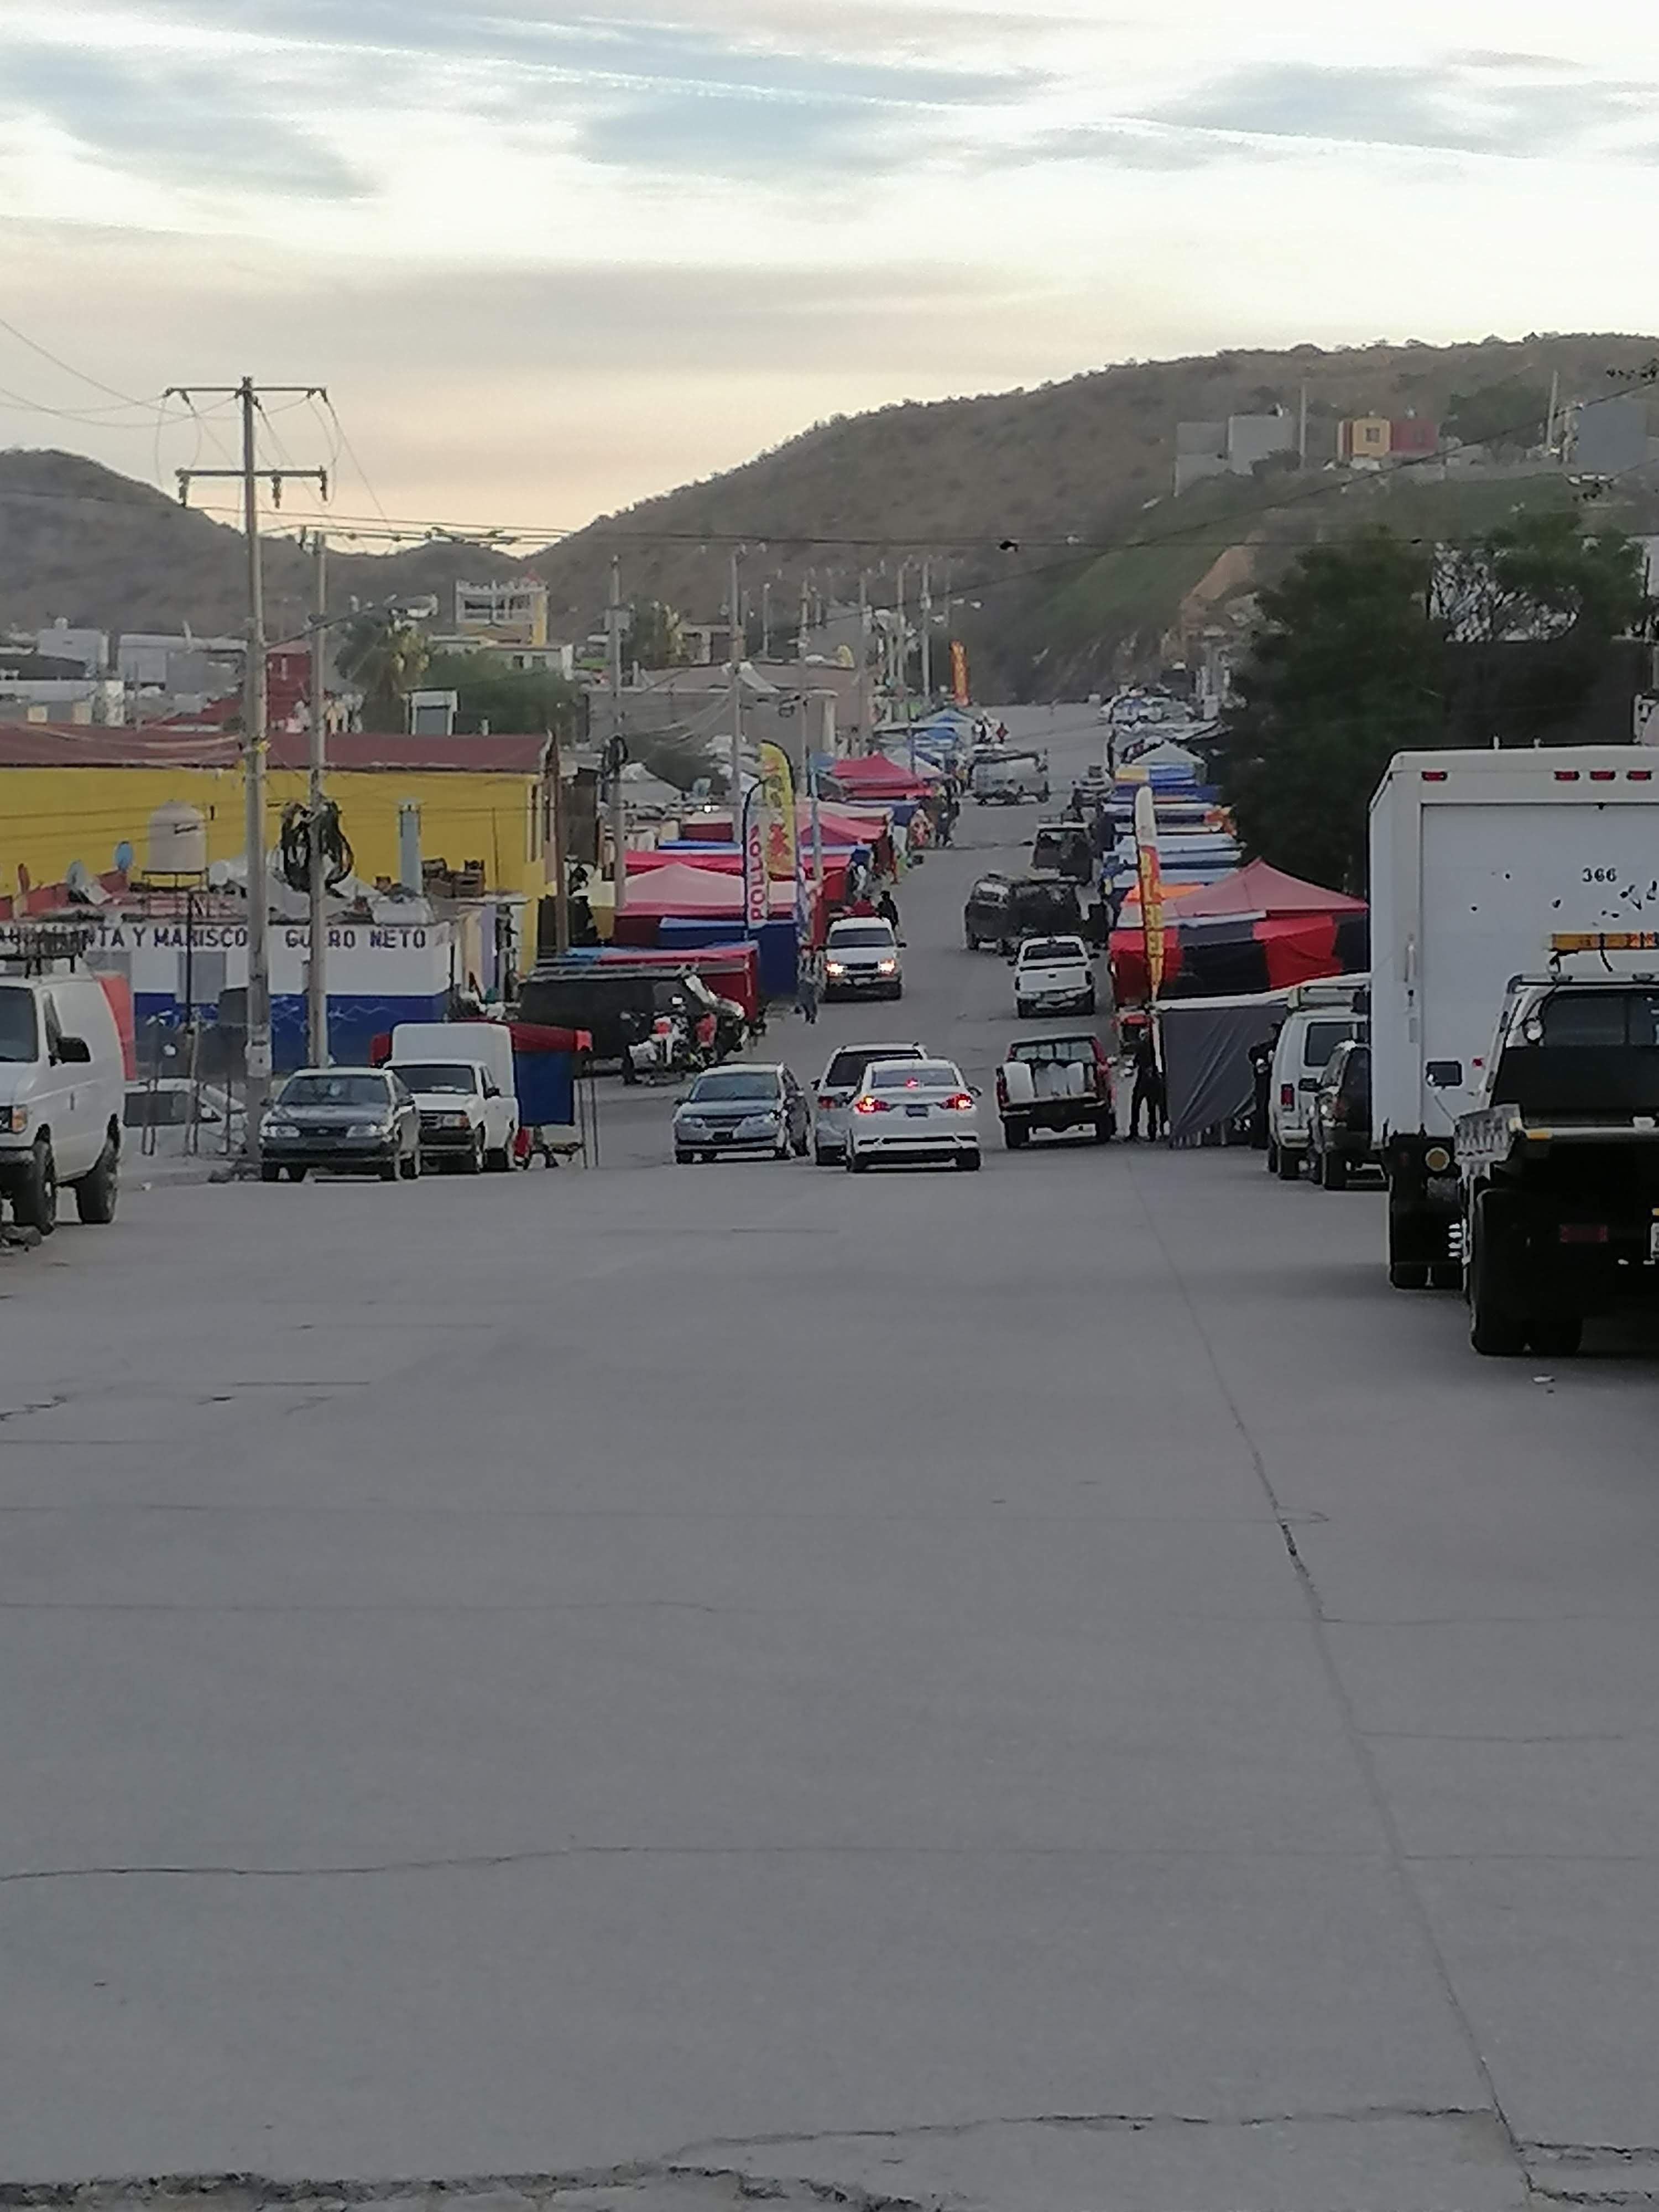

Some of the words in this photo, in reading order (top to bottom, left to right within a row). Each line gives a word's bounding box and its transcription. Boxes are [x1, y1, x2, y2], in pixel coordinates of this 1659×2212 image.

[1583, 868, 1617, 882] 366
[133, 926, 145, 947] Y
[154, 927, 248, 947] MARISCO
[369, 929, 426, 948] NETO
